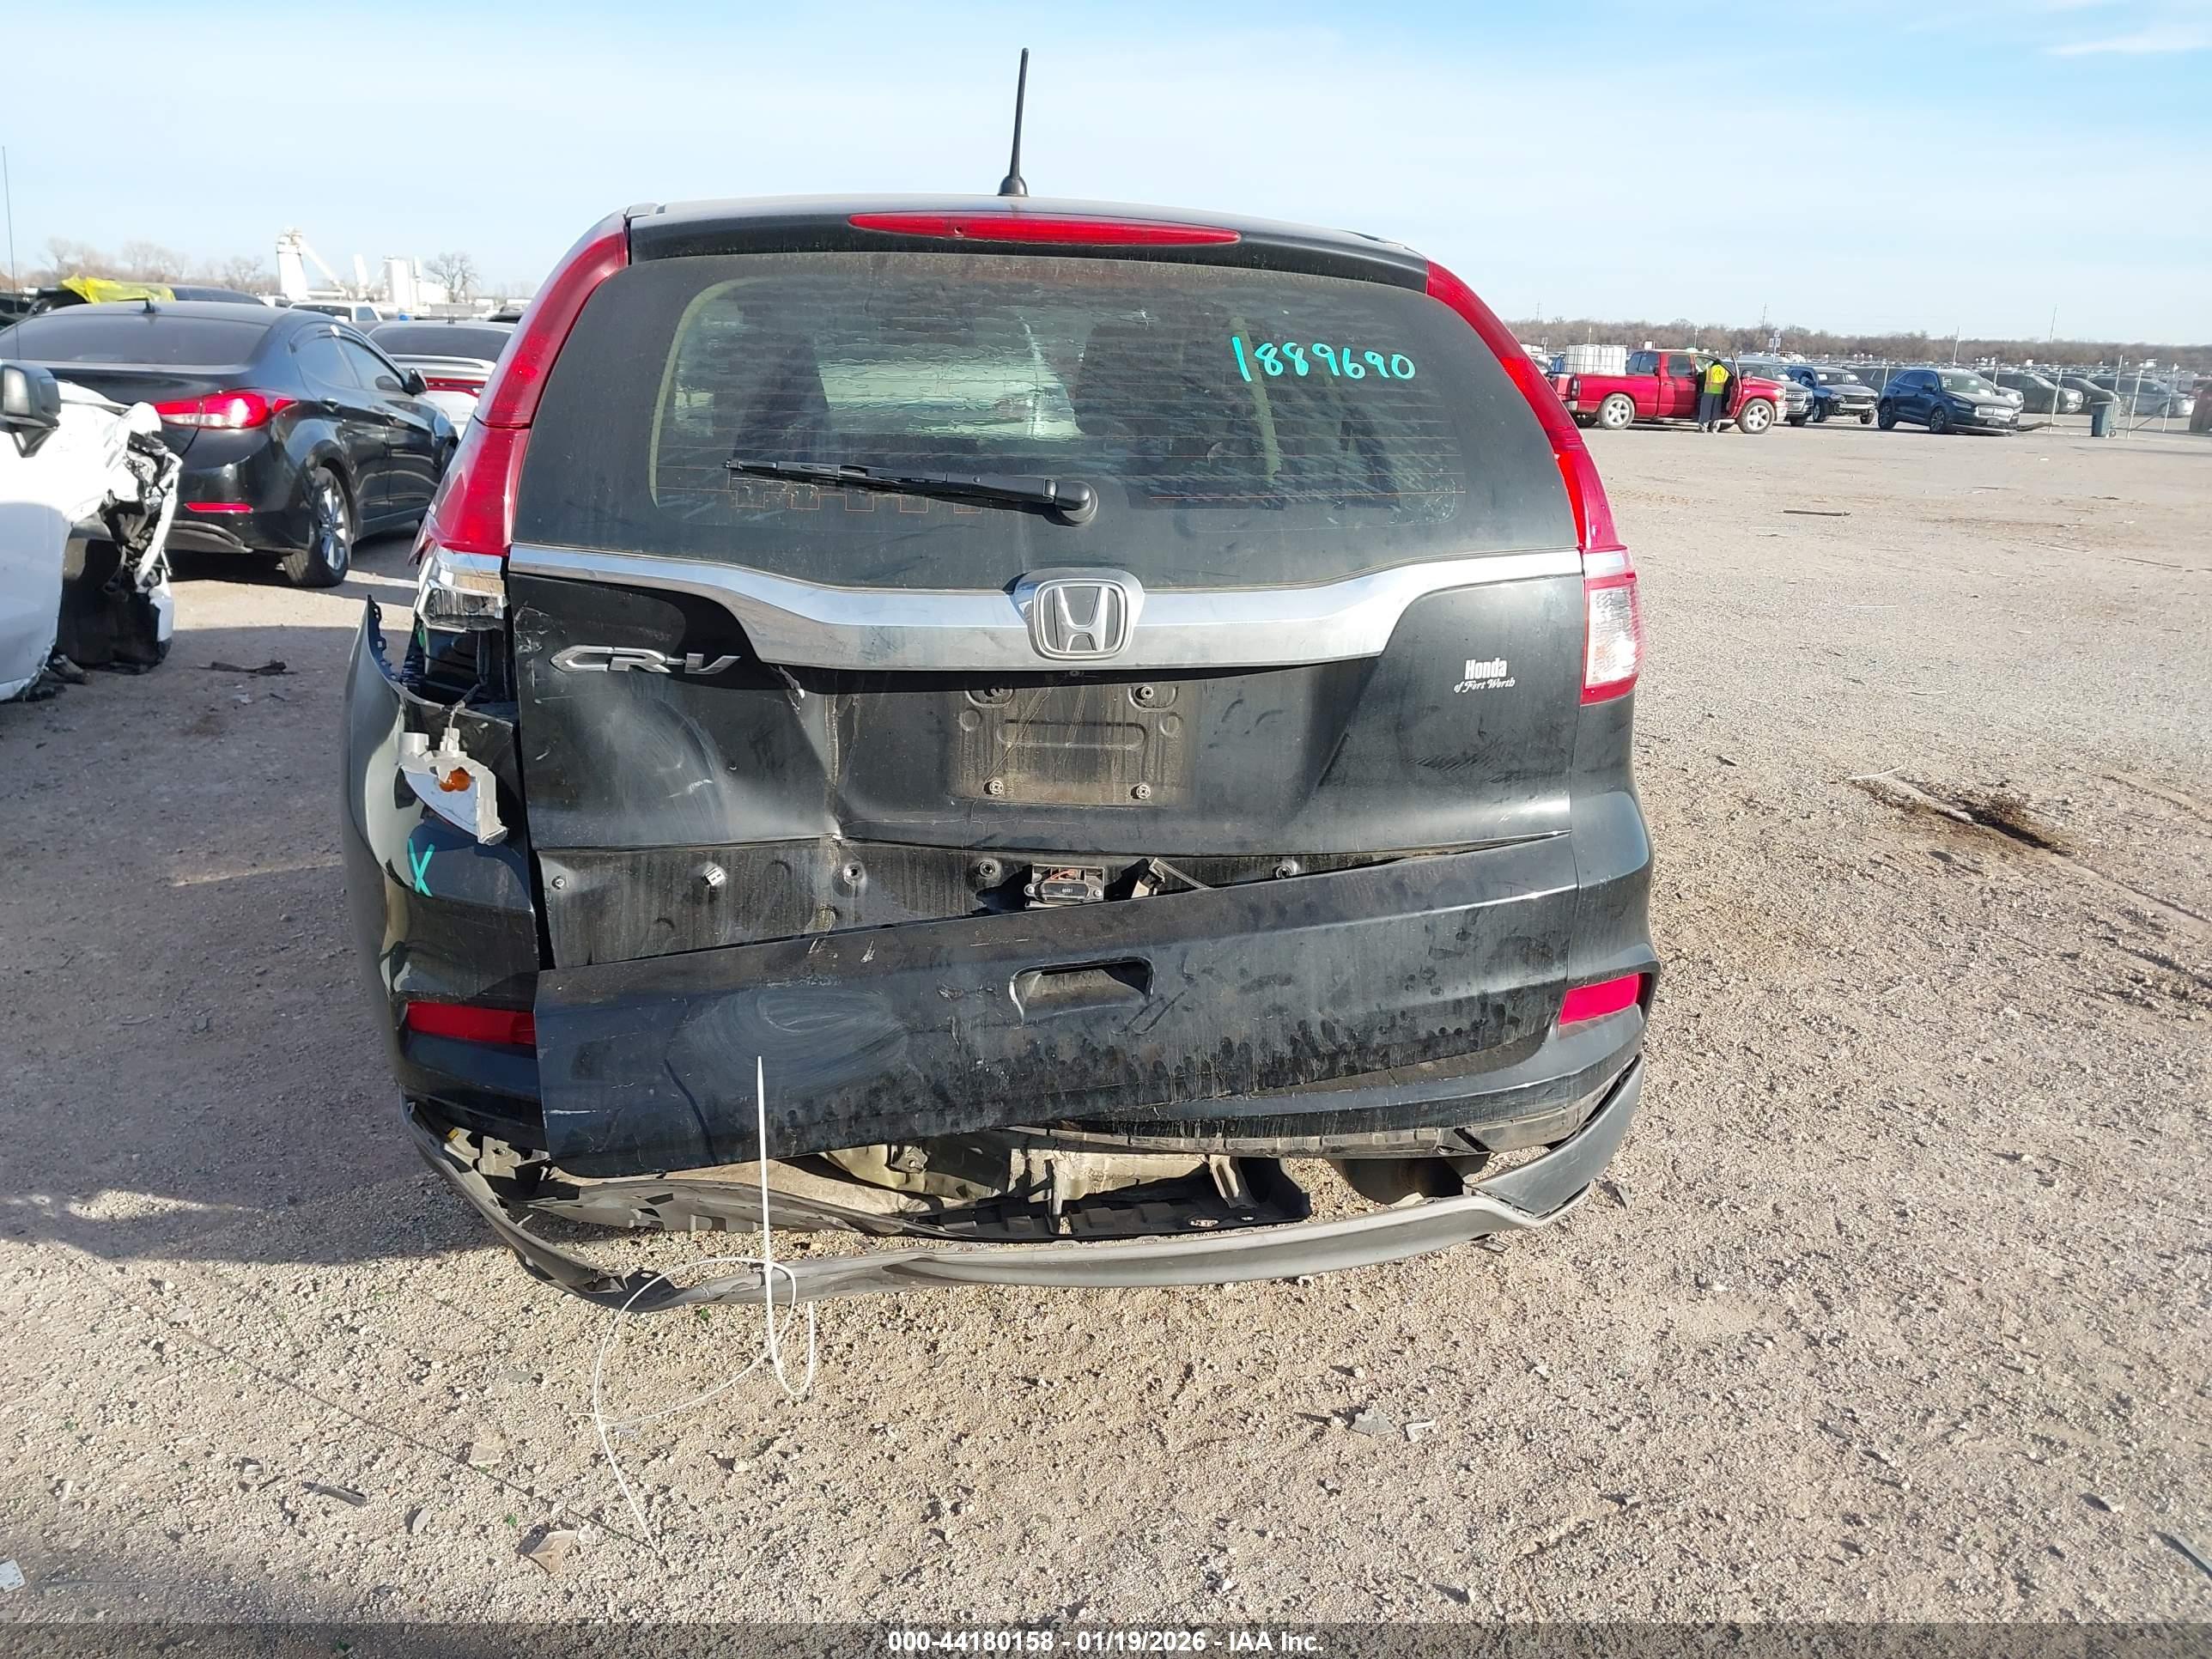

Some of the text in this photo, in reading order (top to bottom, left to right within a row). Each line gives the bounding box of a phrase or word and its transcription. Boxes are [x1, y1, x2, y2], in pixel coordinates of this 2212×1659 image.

[1231, 336, 1416, 382] 1889690
[549, 644, 741, 675] CR-V
[1464, 657, 1507, 680] Honda
[1453, 677, 1516, 693] of Fort Worth
